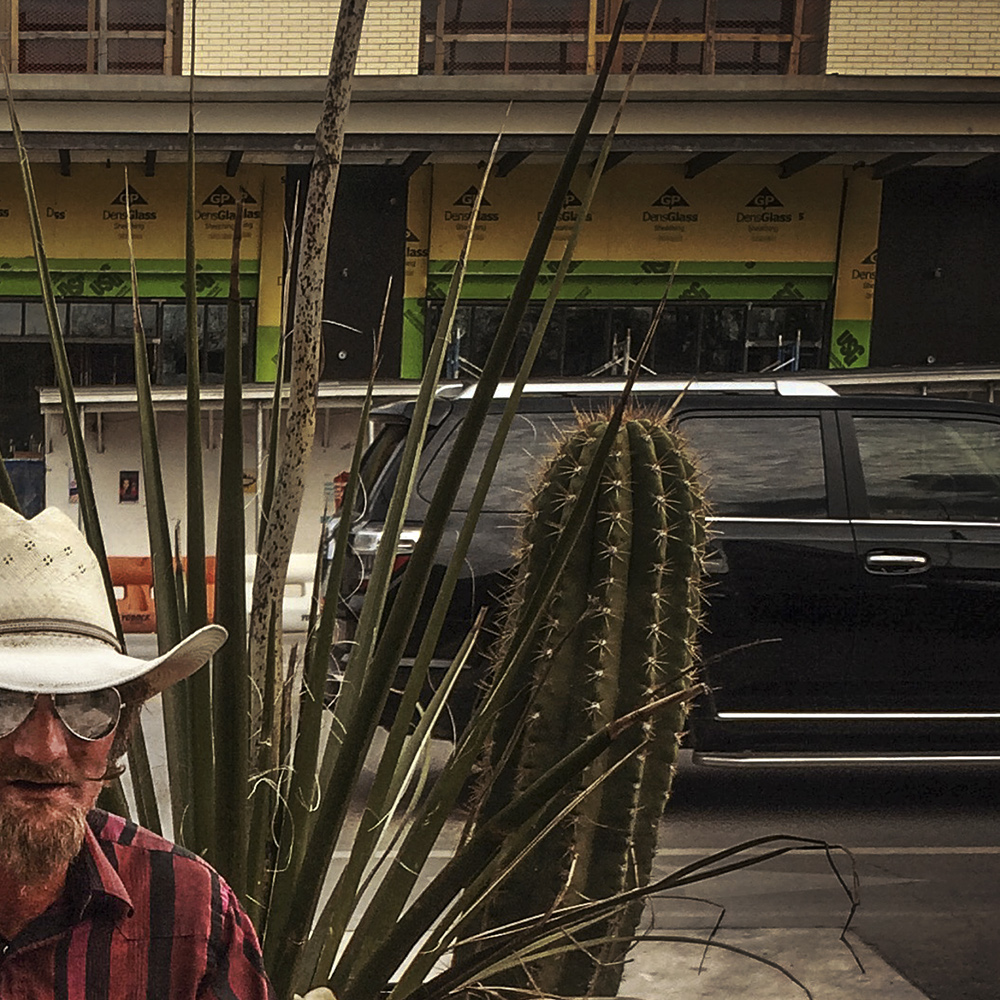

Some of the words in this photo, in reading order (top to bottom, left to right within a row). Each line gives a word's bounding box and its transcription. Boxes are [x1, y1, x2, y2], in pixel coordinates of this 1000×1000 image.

[209, 194, 230, 204] GP
[660, 195, 682, 205] GP
[754, 195, 775, 206] GP
[642, 211, 698, 223] DensGlass
[736, 212, 792, 223] DensGlass
